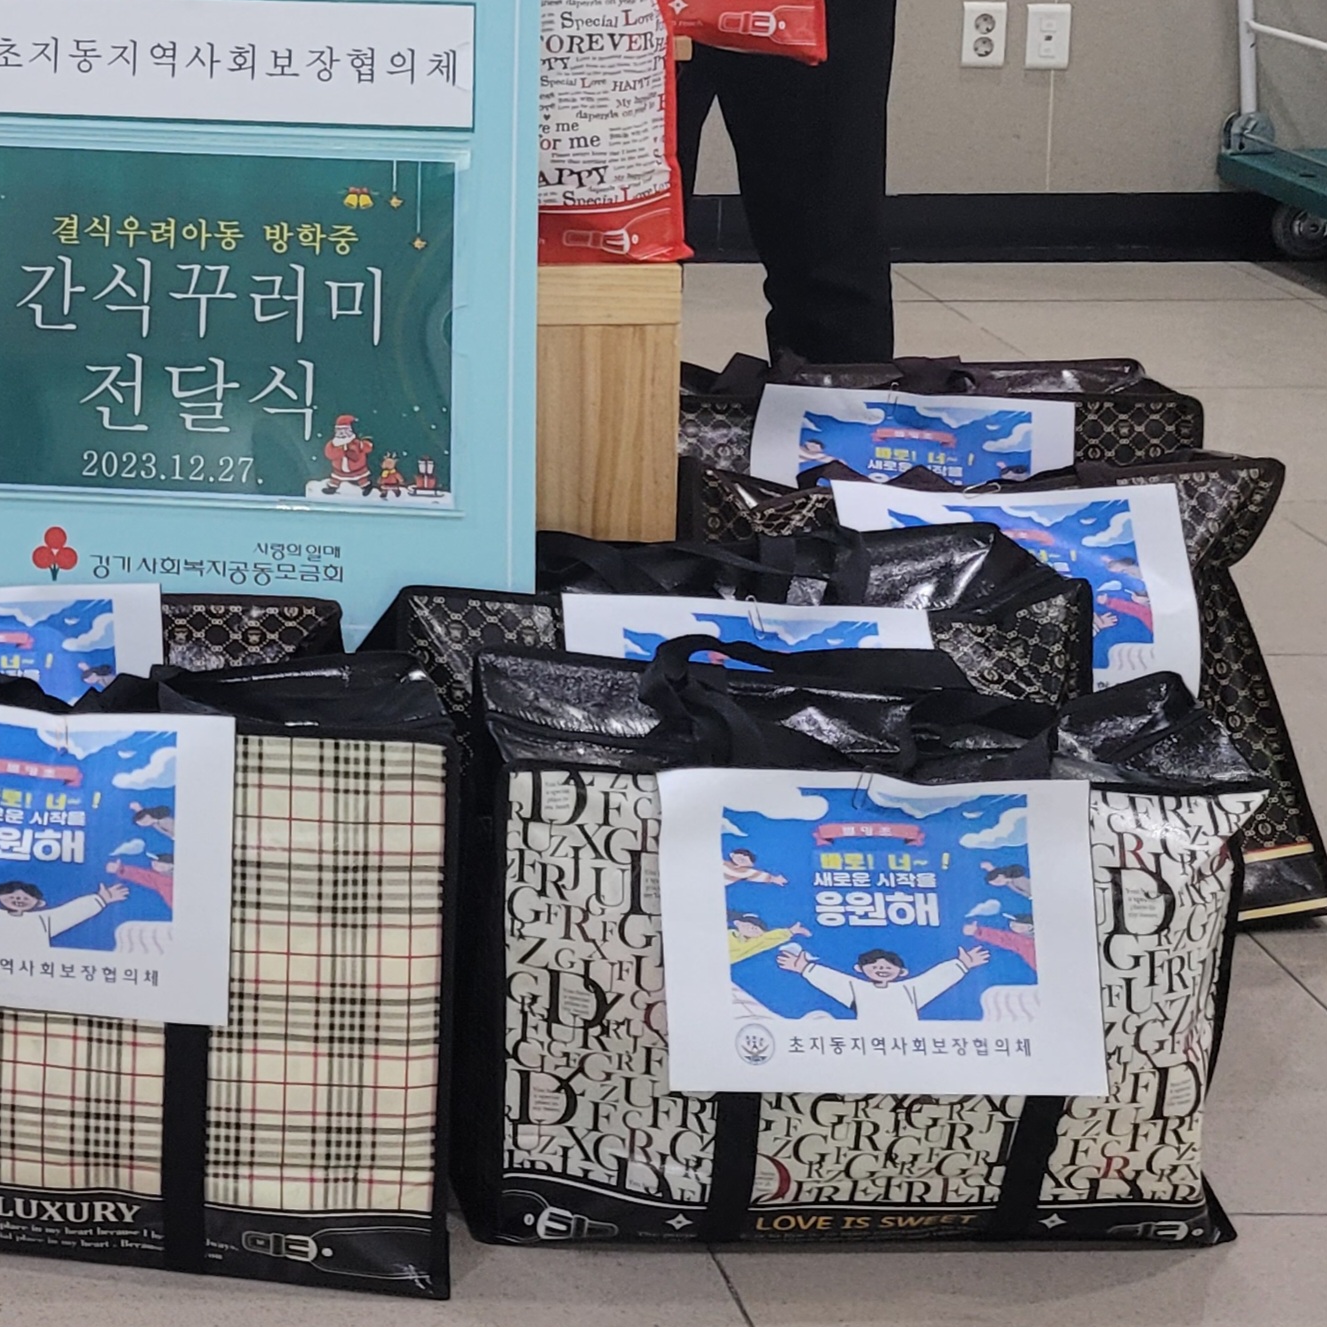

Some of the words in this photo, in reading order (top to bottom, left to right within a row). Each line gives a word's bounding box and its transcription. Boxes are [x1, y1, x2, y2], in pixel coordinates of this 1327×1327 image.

[560, 11, 618, 30] Special
[622, 9, 654, 26] Love
[541, 75, 577, 87] Special
[556, 123, 579, 132] me
[570, 135, 601, 149] me
[52, 214, 245, 252] 결식우려아동
[263, 223, 360, 255] 방학중
[16, 255, 384, 347] 간식꾸러미
[79, 352, 317, 442] 전달식
[81, 451, 265, 485] 2023.12.27.
[137, 556, 344, 586] 사회복지공동모금회
[813, 872, 871, 887] 새로운
[816, 891, 940, 927] 응원해
[788, 1036, 1032, 1057] 초지동지역사회보장협의체
[756, 1216, 834, 1231] LOVE
[842, 1216, 870, 1228] IS
[879, 1214, 976, 1228] SWEET
